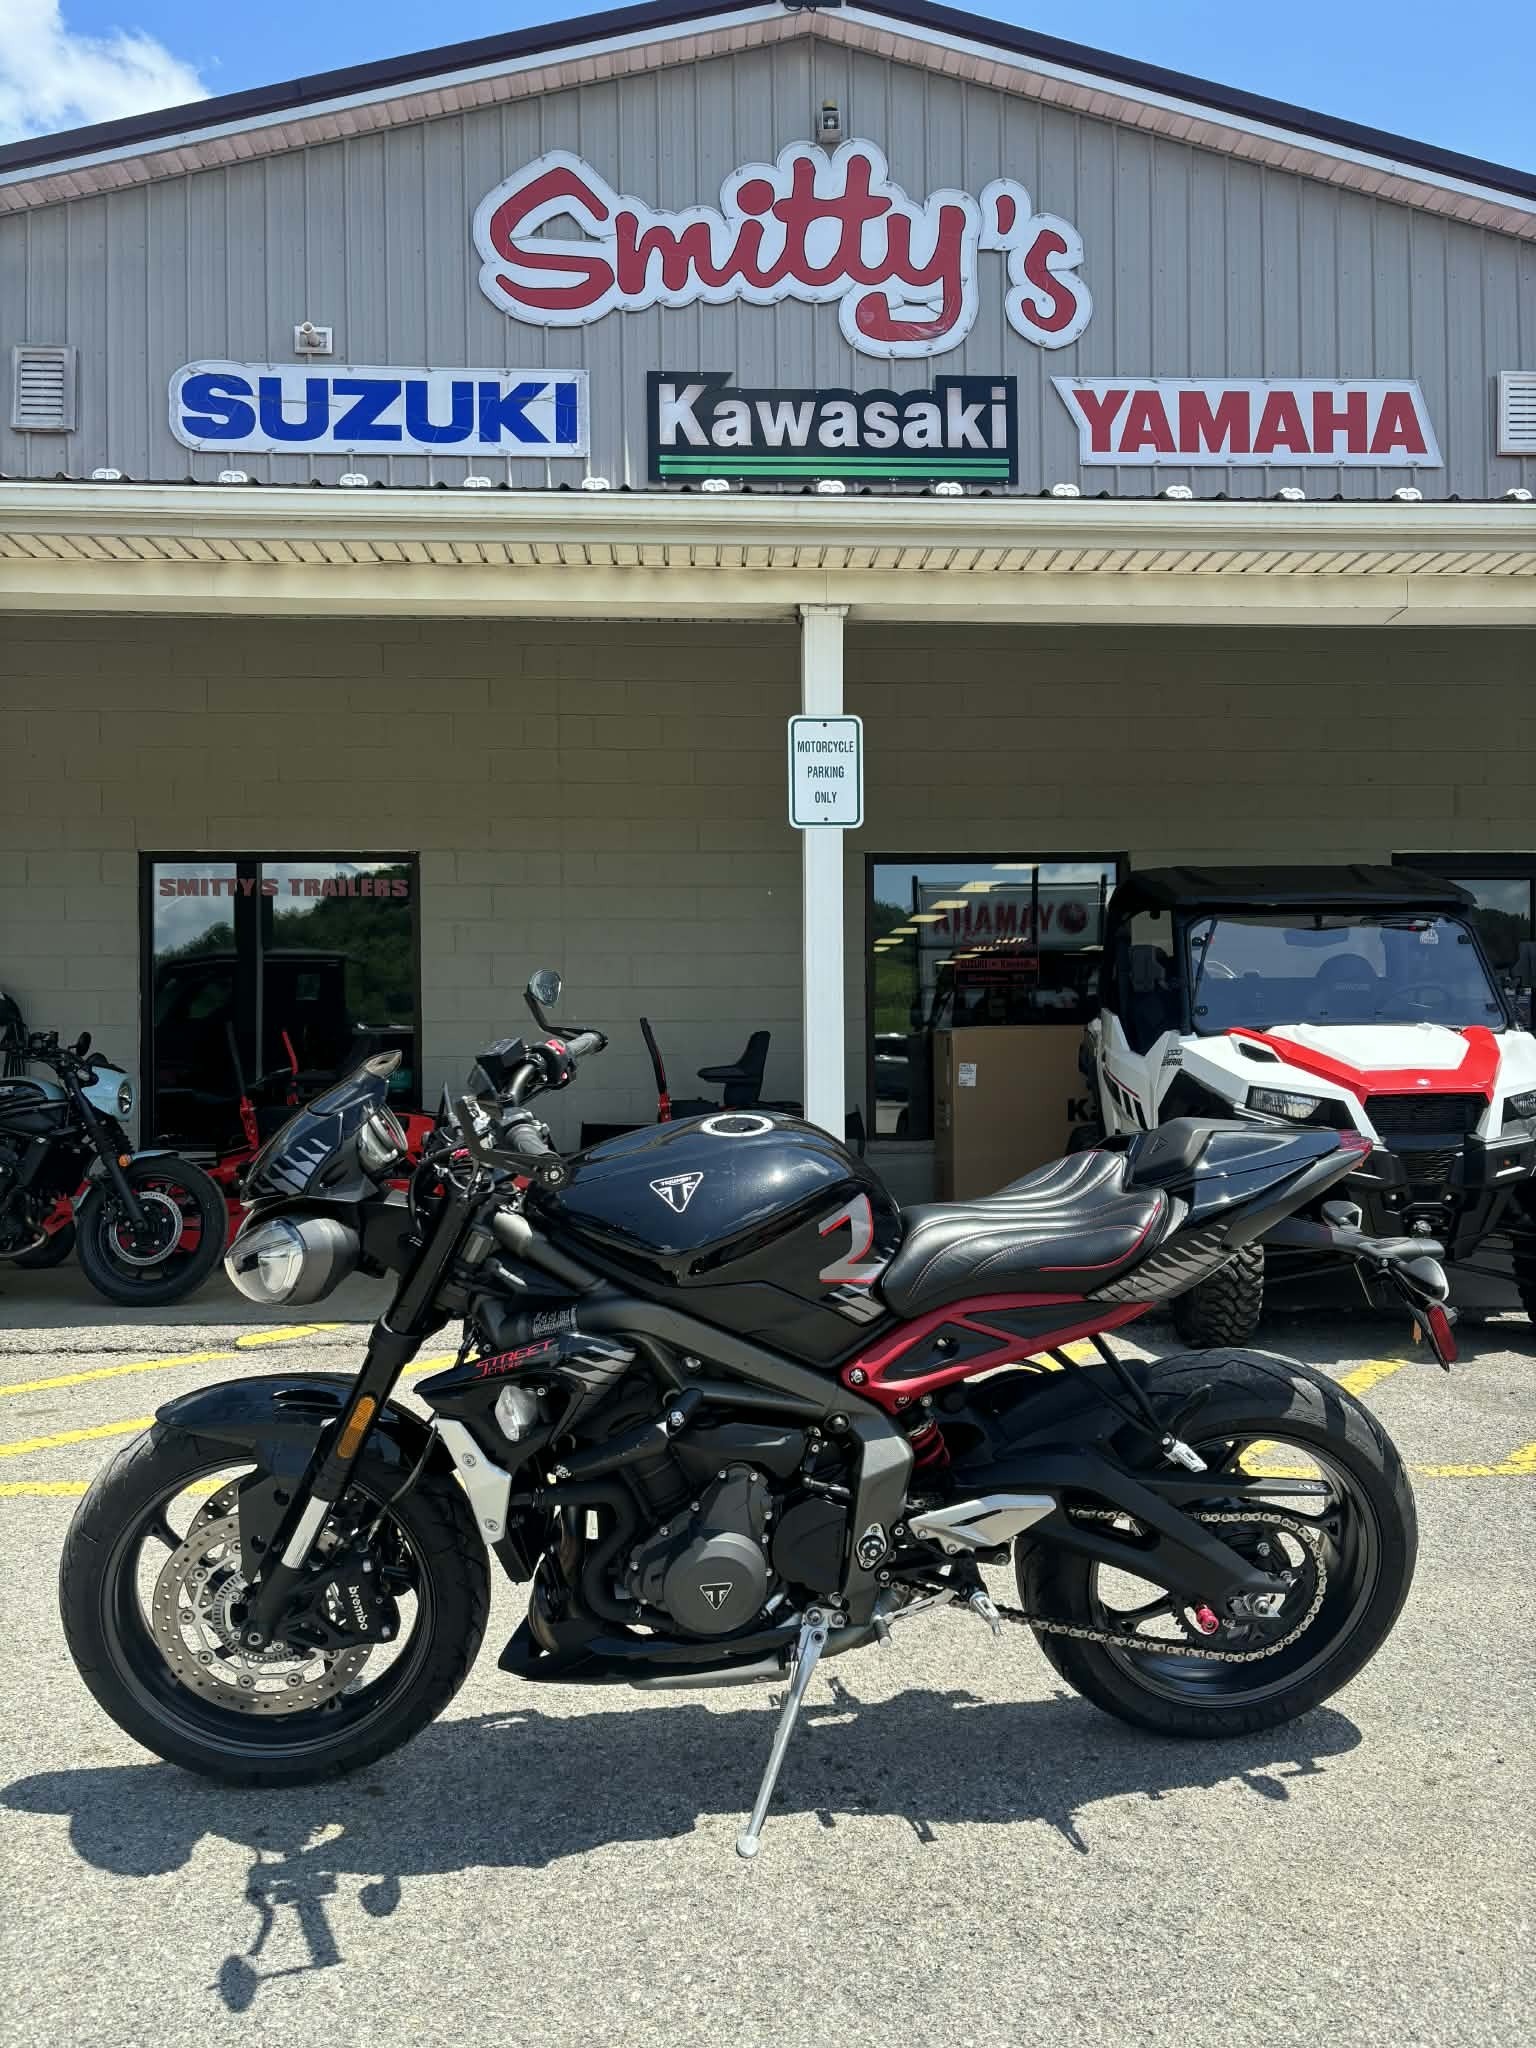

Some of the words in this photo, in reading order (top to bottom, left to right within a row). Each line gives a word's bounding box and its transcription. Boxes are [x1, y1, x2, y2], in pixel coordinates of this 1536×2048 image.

[491, 157, 1075, 342] Smitty's
[180, 373, 579, 445] SUZUKI
[658, 381, 1008, 450] Kawasaki
[1073, 389, 1427, 453] YAMAHA
[797, 741, 855, 753] MOTORCYCLE
[807, 766, 845, 778] PARKING
[814, 791, 837, 804] ONLY
[159, 878, 279, 897] SMITTYS
[288, 878, 409, 897] TRAILERS
[472, 1337, 556, 1379] STREET
[348, 1585, 368, 1631] brembo
